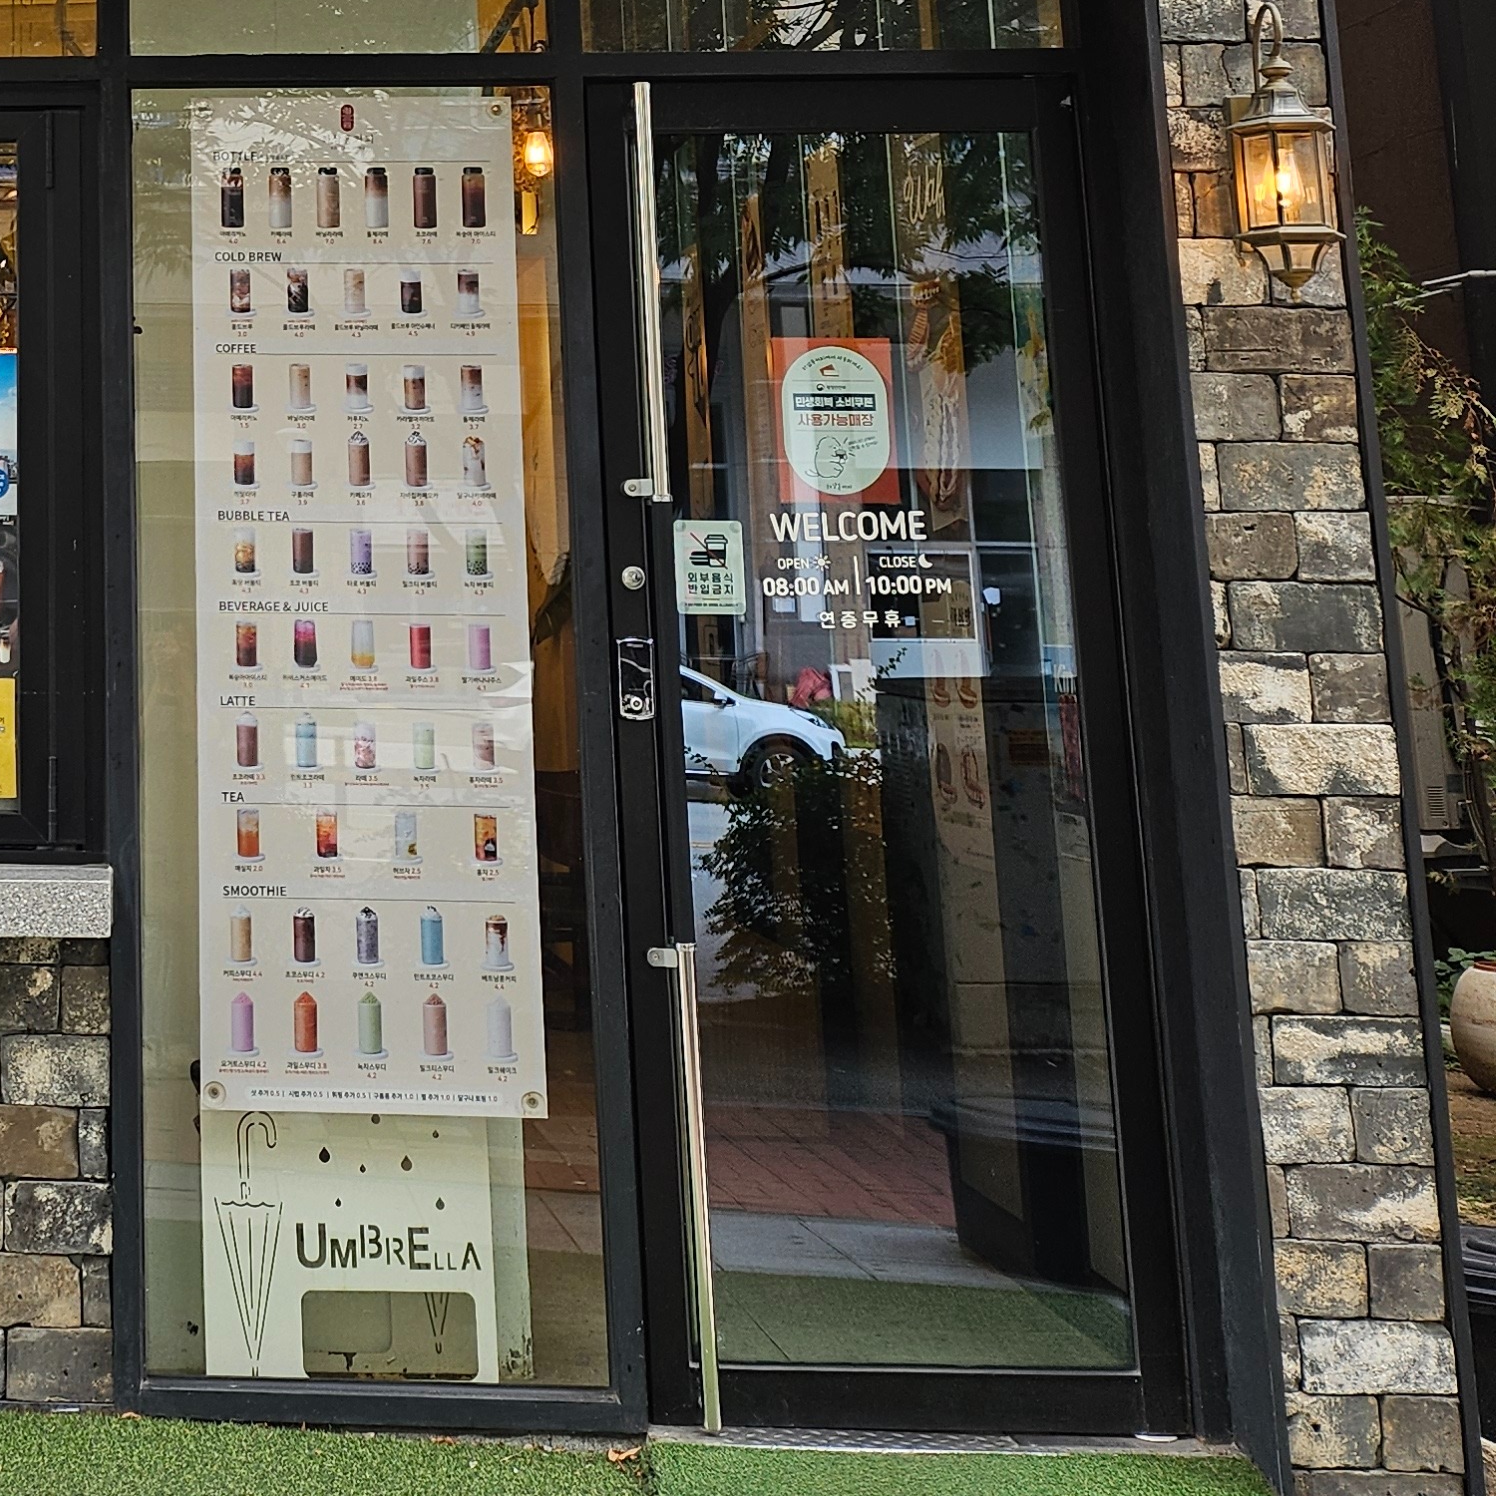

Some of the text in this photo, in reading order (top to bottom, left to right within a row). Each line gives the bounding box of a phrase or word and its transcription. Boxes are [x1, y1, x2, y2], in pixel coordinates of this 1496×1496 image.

[213, 151, 258, 161] BOTTLE
[215, 252, 282, 262] COLD BREW
[215, 343, 257, 354] COFFEE
[798, 413, 875, 427] 사용가능매장
[217, 510, 290, 522] BUBBLE TEA
[770, 510, 928, 543] WELCOME
[777, 558, 810, 570] OPEN
[878, 556, 917, 569] CLOSE
[687, 572, 734, 583] 외부음식
[687, 584, 734, 595] 반입금지
[762, 576, 850, 597] 08:00 AM
[865, 575, 952, 596] 10:00 PM
[219, 601, 329, 612] BEVERAGE & JUICE
[819, 609, 902, 630] 연중무휴
[220, 696, 256, 706] LATTE
[221, 792, 245, 802] TEA
[223, 885, 287, 896] SMOOTHIE
[295, 1222, 481, 1271] UMBRELLA
